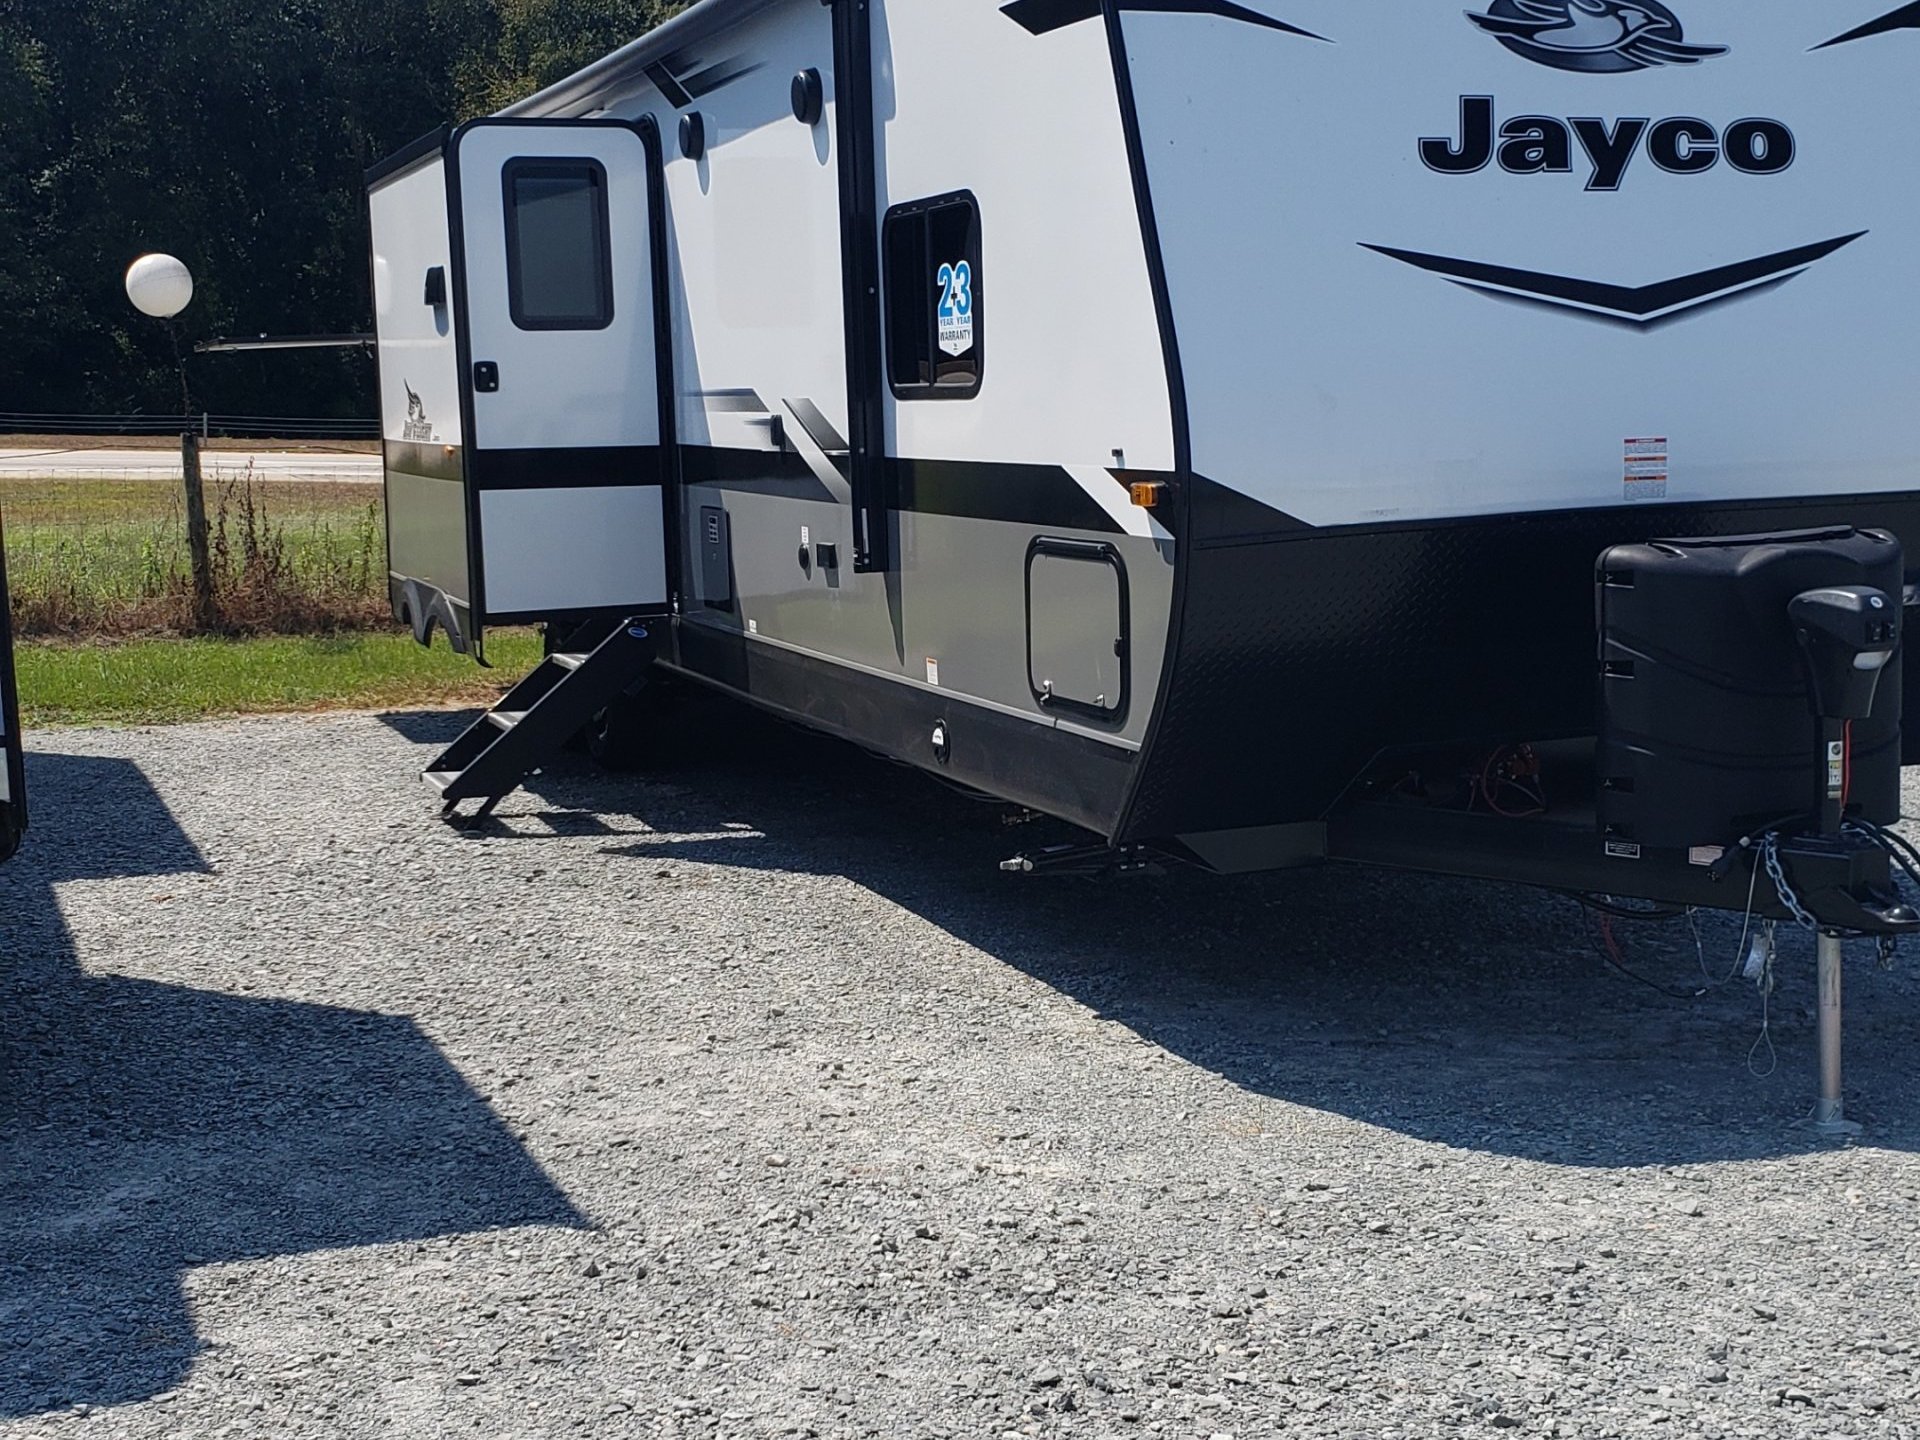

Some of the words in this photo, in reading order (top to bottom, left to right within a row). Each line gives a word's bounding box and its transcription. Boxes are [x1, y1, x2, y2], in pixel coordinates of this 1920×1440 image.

[1418, 94, 1797, 192] Jayco
[940, 317, 953, 326] YEAR
[956, 316, 971, 325] YEAR
[940, 329, 971, 342] WARRANTY
